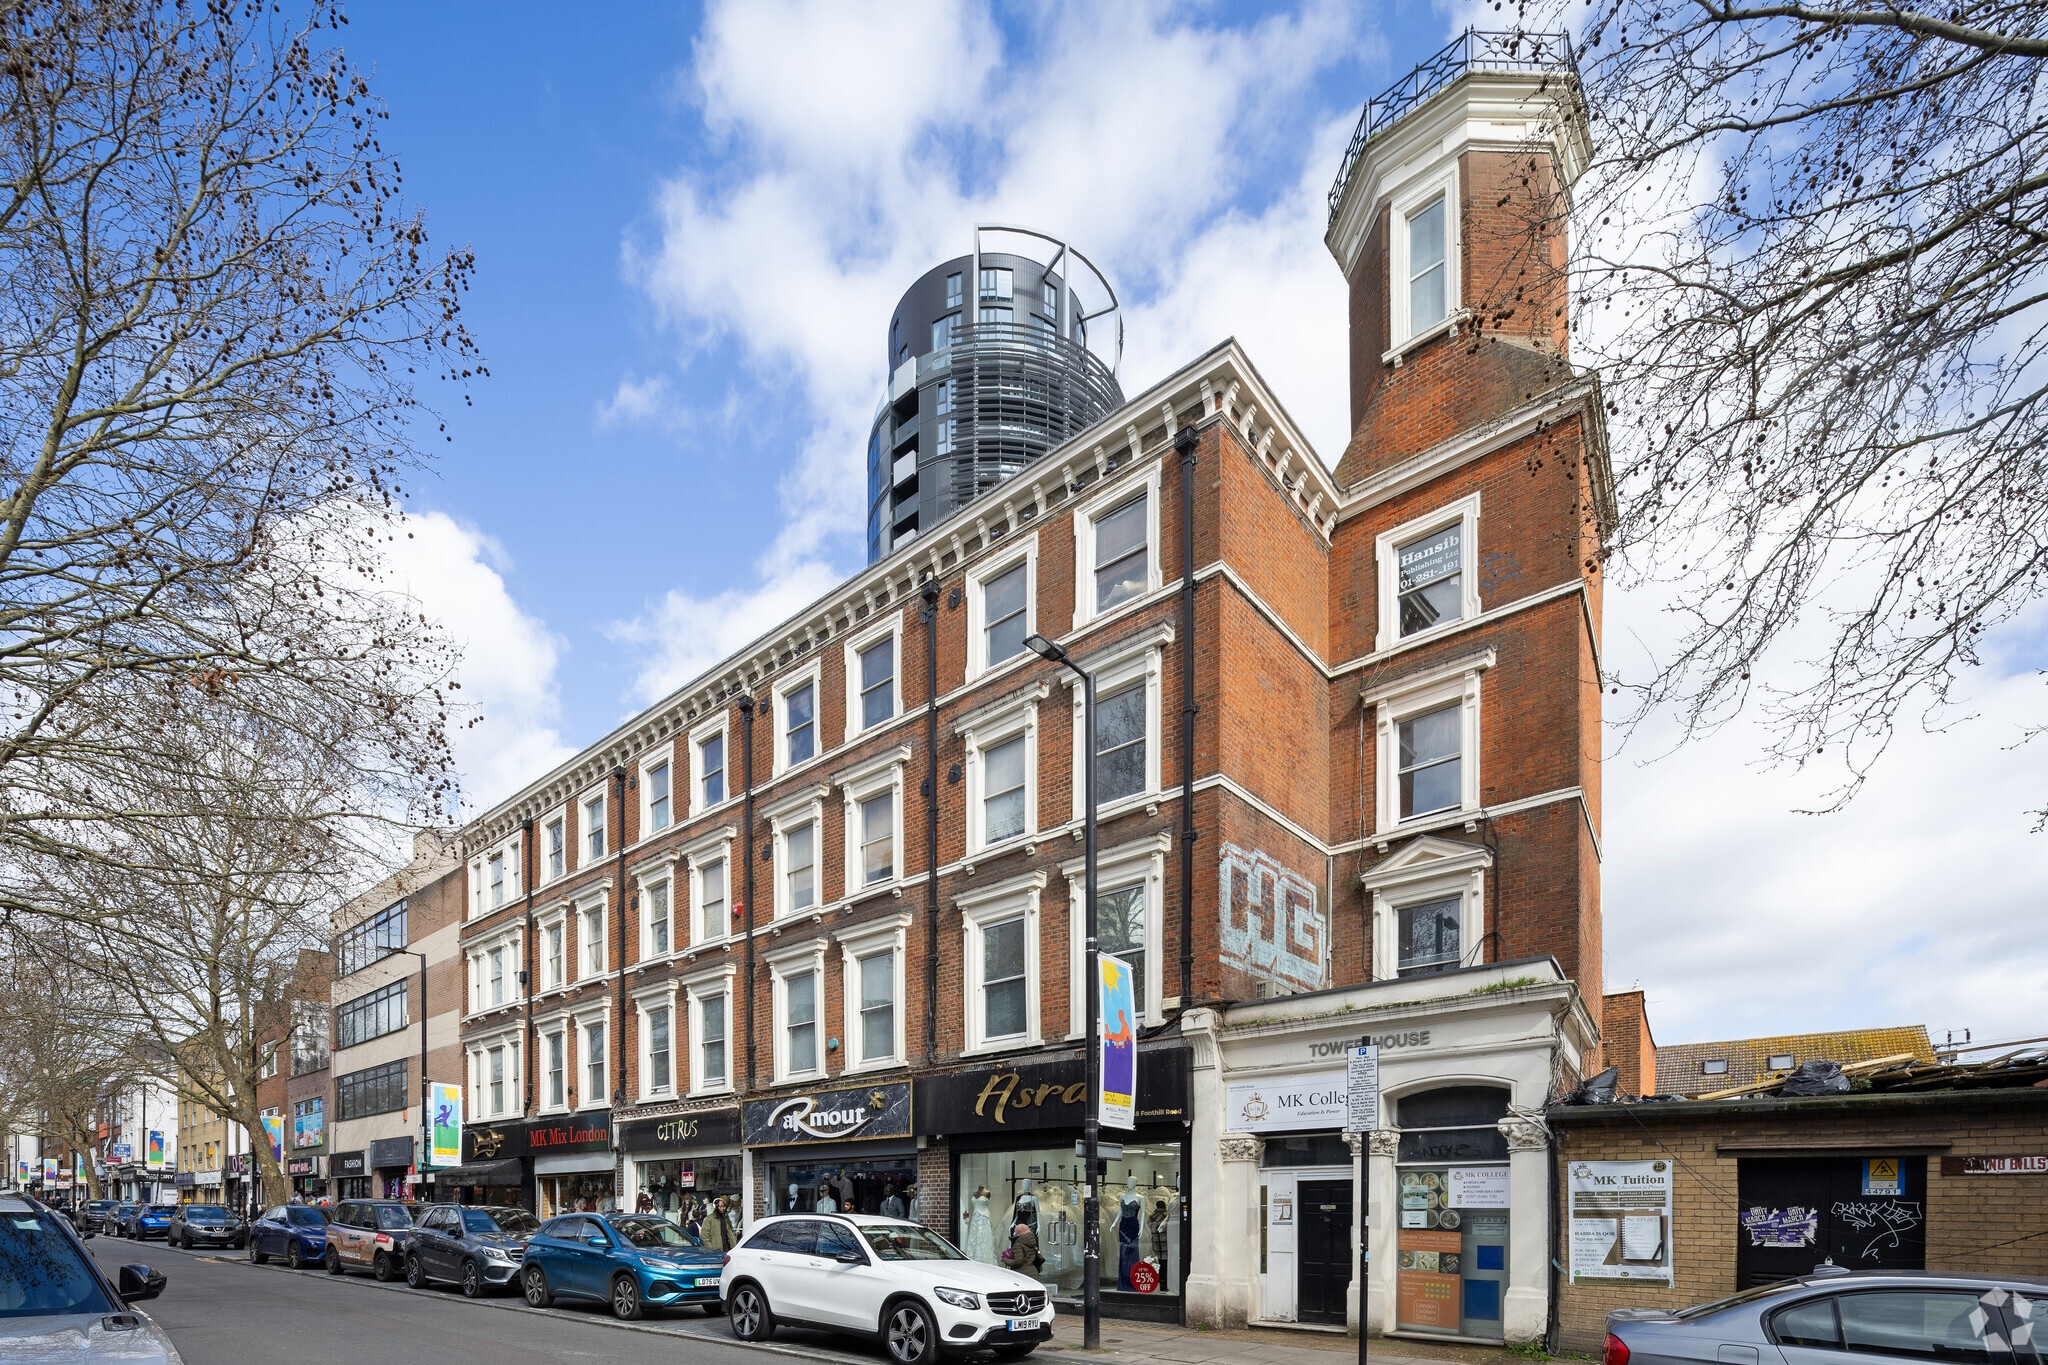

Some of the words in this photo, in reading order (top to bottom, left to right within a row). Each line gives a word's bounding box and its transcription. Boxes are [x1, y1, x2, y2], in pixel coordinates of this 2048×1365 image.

[1400, 535, 1459, 567] Hansib
[1401, 556, 1443, 577] Publishing
[1445, 549, 1459, 559] Ltd
[1373, 1031, 1430, 1049] HOUSE
[1278, 1094, 1304, 1108] MK
[530, 1129, 547, 1147] MK
[549, 1128, 567, 1145] Mix
[569, 1124, 607, 1143] London
[658, 1120, 698, 1140] CITRUS
[344, 1159, 361, 1168] FASHION
[1988, 1158, 2005, 1170] NO
[2010, 1157, 2046, 1170] BILLS
[1594, 1176, 1617, 1185] MK
[1621, 1175, 1665, 1184] Tuition
[1750, 1207, 1767, 1216] UNITY
[1787, 1207, 1804, 1216] UNITY
[1745, 1215, 1766, 1223] MARCH
[1782, 1215, 1804, 1223] MARCH
[1135, 1273, 1154, 1283] 25%
